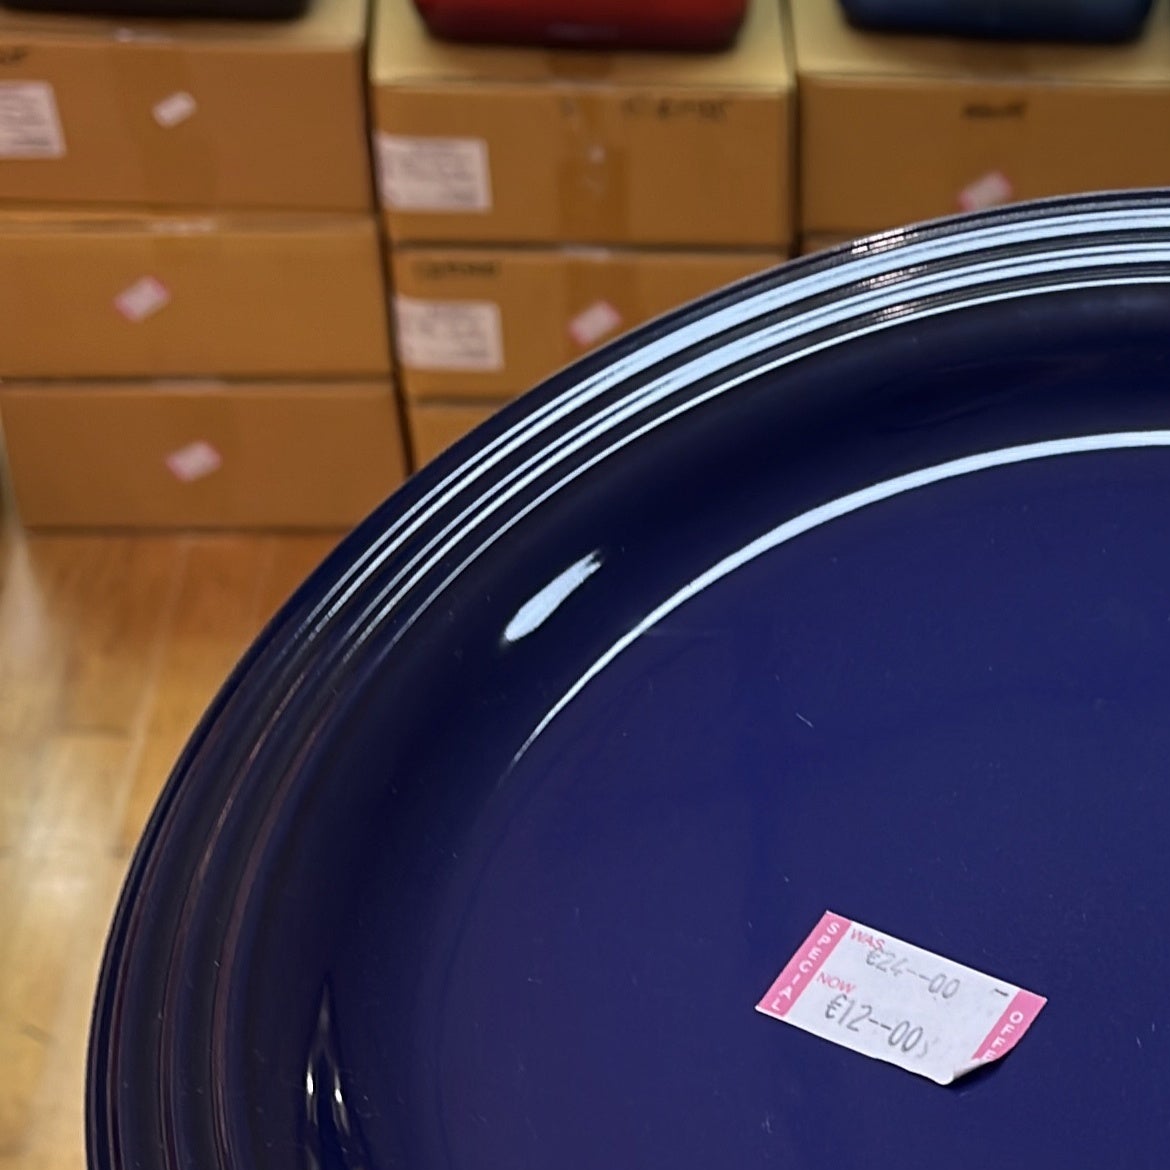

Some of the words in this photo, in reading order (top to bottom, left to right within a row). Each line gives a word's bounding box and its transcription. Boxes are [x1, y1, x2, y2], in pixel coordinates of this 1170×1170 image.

[851, 928, 886, 952] WAS
[771, 922, 840, 1012] SPECIAL
[817, 972, 857, 994] NOW
